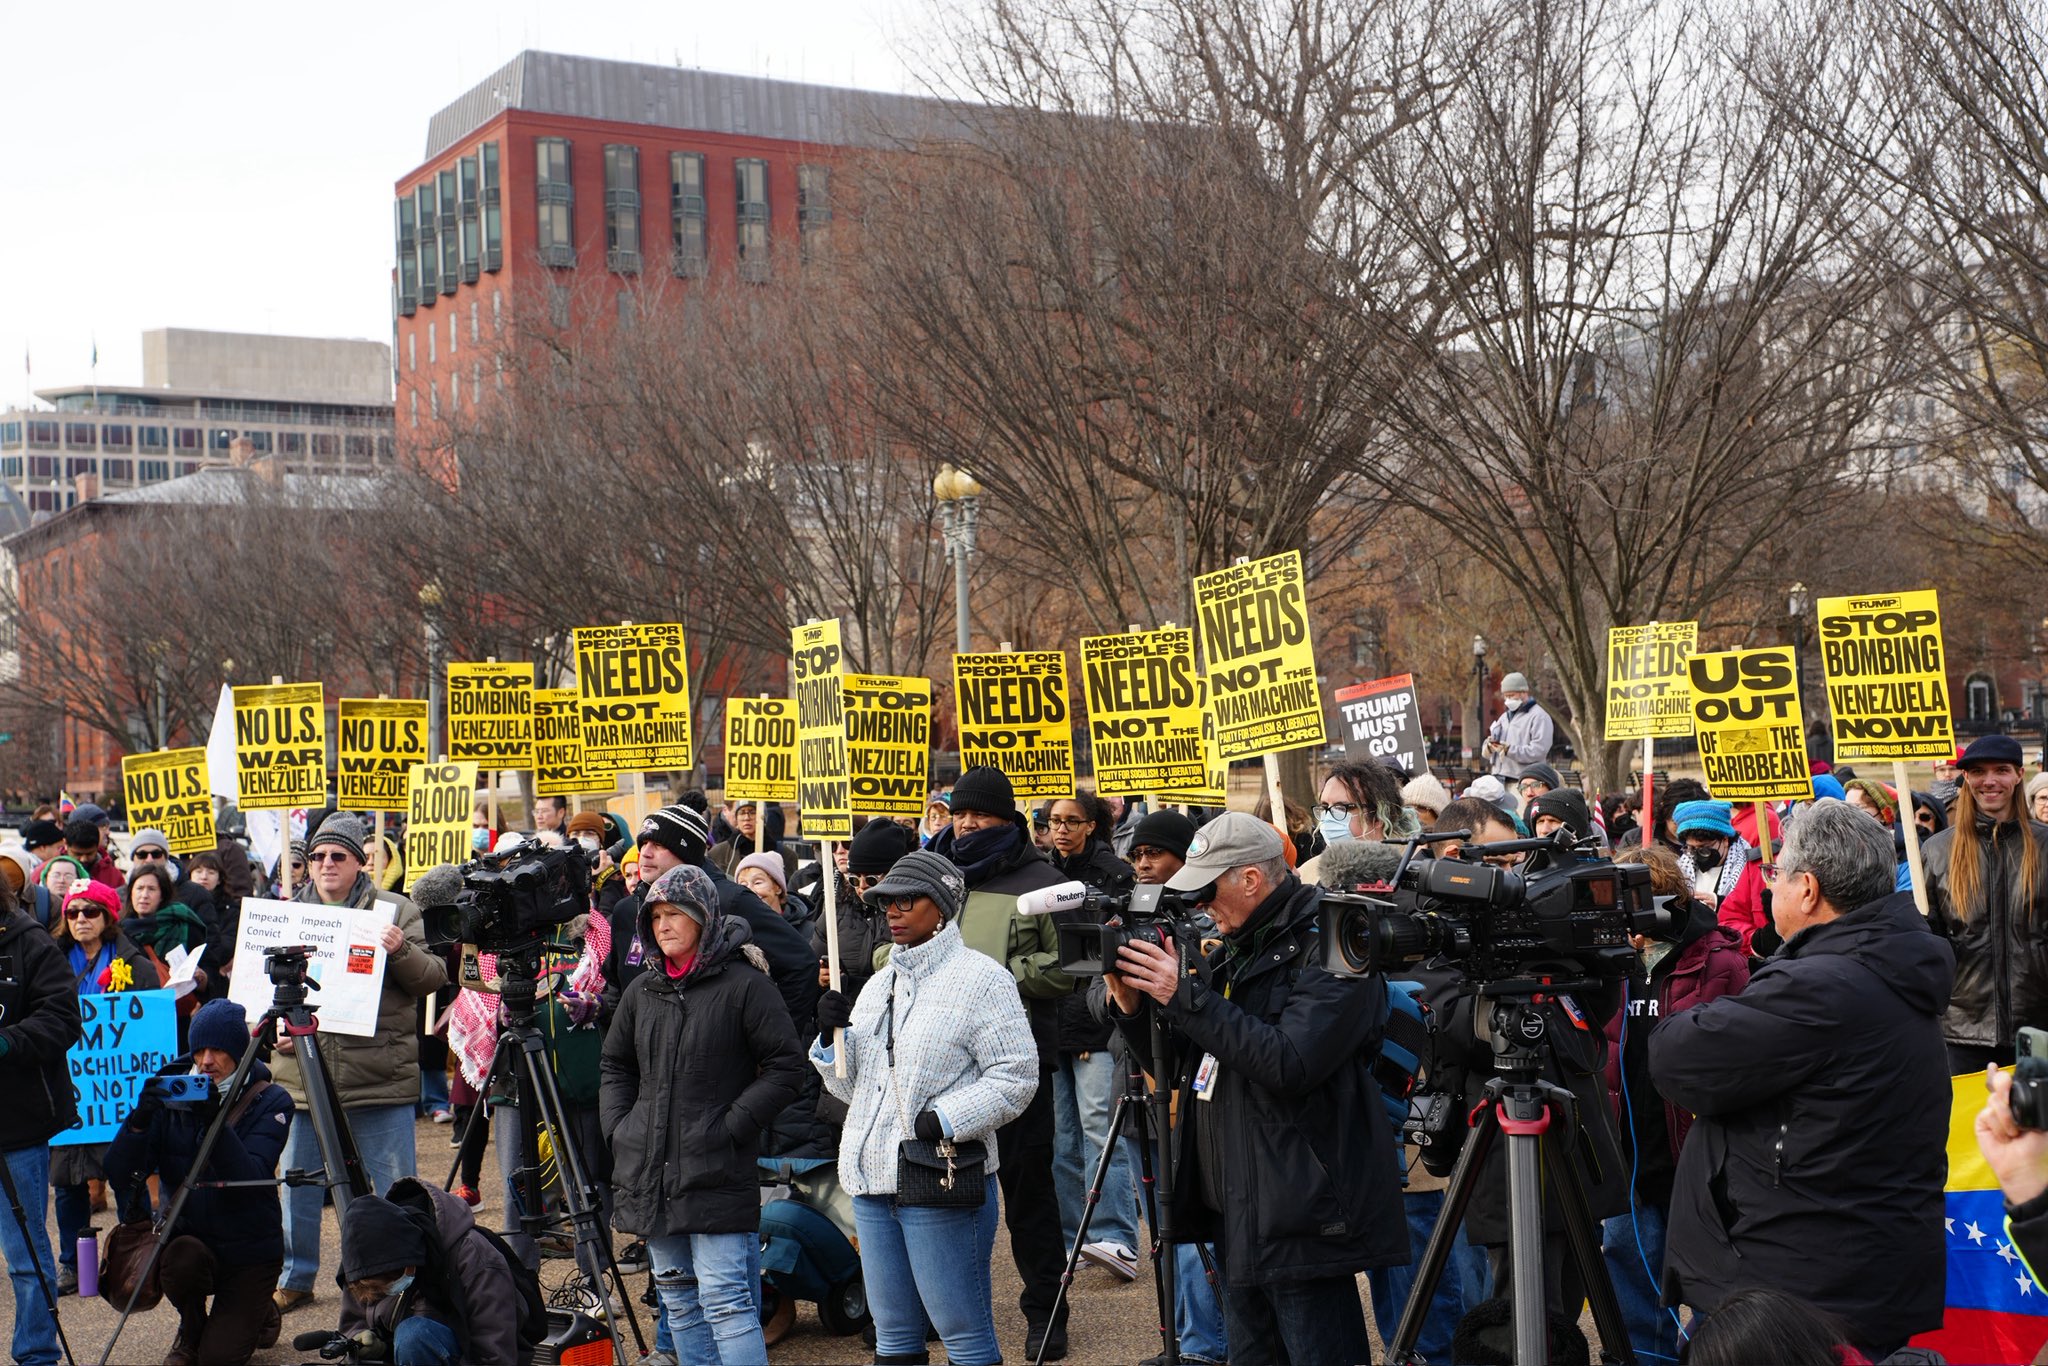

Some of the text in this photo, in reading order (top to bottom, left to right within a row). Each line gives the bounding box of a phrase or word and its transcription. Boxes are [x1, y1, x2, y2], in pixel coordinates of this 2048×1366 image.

[1198, 554, 1297, 590] MONEY FOR
[1199, 567, 1299, 605] PEOPLE'S
[1850, 600, 1897, 609] TRUMP
[578, 626, 680, 639] MONEY FOR
[1203, 582, 1305, 665] NEEDS
[1613, 624, 1694, 636] MONEY FOR
[1822, 610, 1937, 638] STOP
[578, 636, 681, 650] PEOPLE'S
[1085, 631, 1189, 649] MONEY FOR
[1613, 632, 1693, 645] PEOPLE'S
[957, 653, 1062, 665] MONEY FOR
[1085, 642, 1190, 661] PEOPLE'S
[1612, 641, 1692, 681] NEEDS
[1825, 635, 1941, 677] BOMBING
[580, 647, 684, 698] NEEDS
[958, 663, 1062, 676] PEOPLE'S
[1211, 657, 1313, 697] NOT THE
[1689, 653, 1792, 694] US
[450, 676, 532, 690] STOP
[858, 679, 899, 687] TRUMP
[1087, 655, 1194, 713] NEEDS
[1610, 682, 1670, 700] NOT
[451, 690, 531, 715] BOMBING
[743, 701, 784, 716] NO
[844, 689, 928, 710] STOP
[959, 676, 1065, 725] NEEDS
[1214, 691, 1249, 727] WAR
[1249, 678, 1317, 720] MACHINE
[1341, 692, 1411, 722] TRUMP
[1610, 698, 1691, 718] WAR MACHINE
[1695, 693, 1795, 723] OUT
[1830, 680, 1947, 715] VENEZUELA
[582, 702, 660, 722] NOT
[660, 711, 687, 719] THE
[236, 706, 322, 746] NO U.S.
[342, 719, 425, 753] NO U.S.
[451, 720, 532, 740] VENEZUELA
[535, 716, 580, 740] BOMB
[584, 721, 687, 747] WAR MACHINE
[731, 717, 795, 747] BLOOD
[846, 710, 927, 744] OMBING
[1093, 716, 1199, 740] NOT THE
[1219, 730, 1239, 744] PARTY
[1238, 727, 1250, 740] FOR
[1276, 720, 1285, 732] &
[1352, 713, 1407, 741] MUST
[1836, 715, 1949, 739] NOW!
[451, 742, 532, 756] NOW!
[962, 730, 1069, 749] NOT THE
[1220, 726, 1321, 756] PSLWEB.ORG
[1369, 735, 1398, 757] GO
[1701, 726, 1802, 754] OF THE
[1840, 743, 1950, 756] PARTY FOR SOCIALISM & LIBERATION
[238, 749, 323, 769] WAR
[536, 744, 581, 765] VENEZ
[586, 751, 605, 761] PARTY
[605, 750, 617, 760] FOR
[647, 748, 654, 757] &
[848, 748, 925, 776] NEZUELA
[964, 749, 1070, 772] WAR MACHINE
[1096, 737, 1202, 766] WAR MACHINE
[341, 758, 425, 774] WAR
[587, 757, 687, 769] PSLWEB.ORG
[728, 752, 796, 781] FOR OIL
[1099, 765, 1202, 781] PARTY FOR SOCIALISM & LIBERATION
[1705, 752, 1806, 782] CARIBBEAN
[127, 767, 208, 804] NO U.S.
[239, 768, 324, 795] VENEZUELA
[424, 765, 460, 784] NO
[1028, 776, 1036, 785] &
[1037, 774, 1070, 784] LIBERATION
[1100, 775, 1204, 791] PSLWEB.ORG
[341, 775, 409, 797] VENEZUE
[802, 782, 848, 809] NOW!
[851, 777, 925, 797] OW!
[1014, 785, 1070, 795] EB.ORG
[1766, 786, 1774, 794] &
[131, 801, 210, 823] WAR
[412, 786, 470, 824] BLOOD
[886, 802, 893, 810] &
[132, 817, 213, 839] EZUELA
[409, 830, 468, 867] FOR OIL
[1057, 891, 1084, 902] Reuters
[248, 911, 289, 924] Impeach
[301, 916, 342, 930] Impeach
[247, 926, 281, 939] Convict
[298, 931, 335, 944] Convict
[244, 941, 268, 952] Rem
[103, 995, 144, 1021] TO
[78, 1022, 127, 1051] MY
[71, 1051, 175, 1077] DCHILDREN
[91, 1076, 137, 1102] NOT
